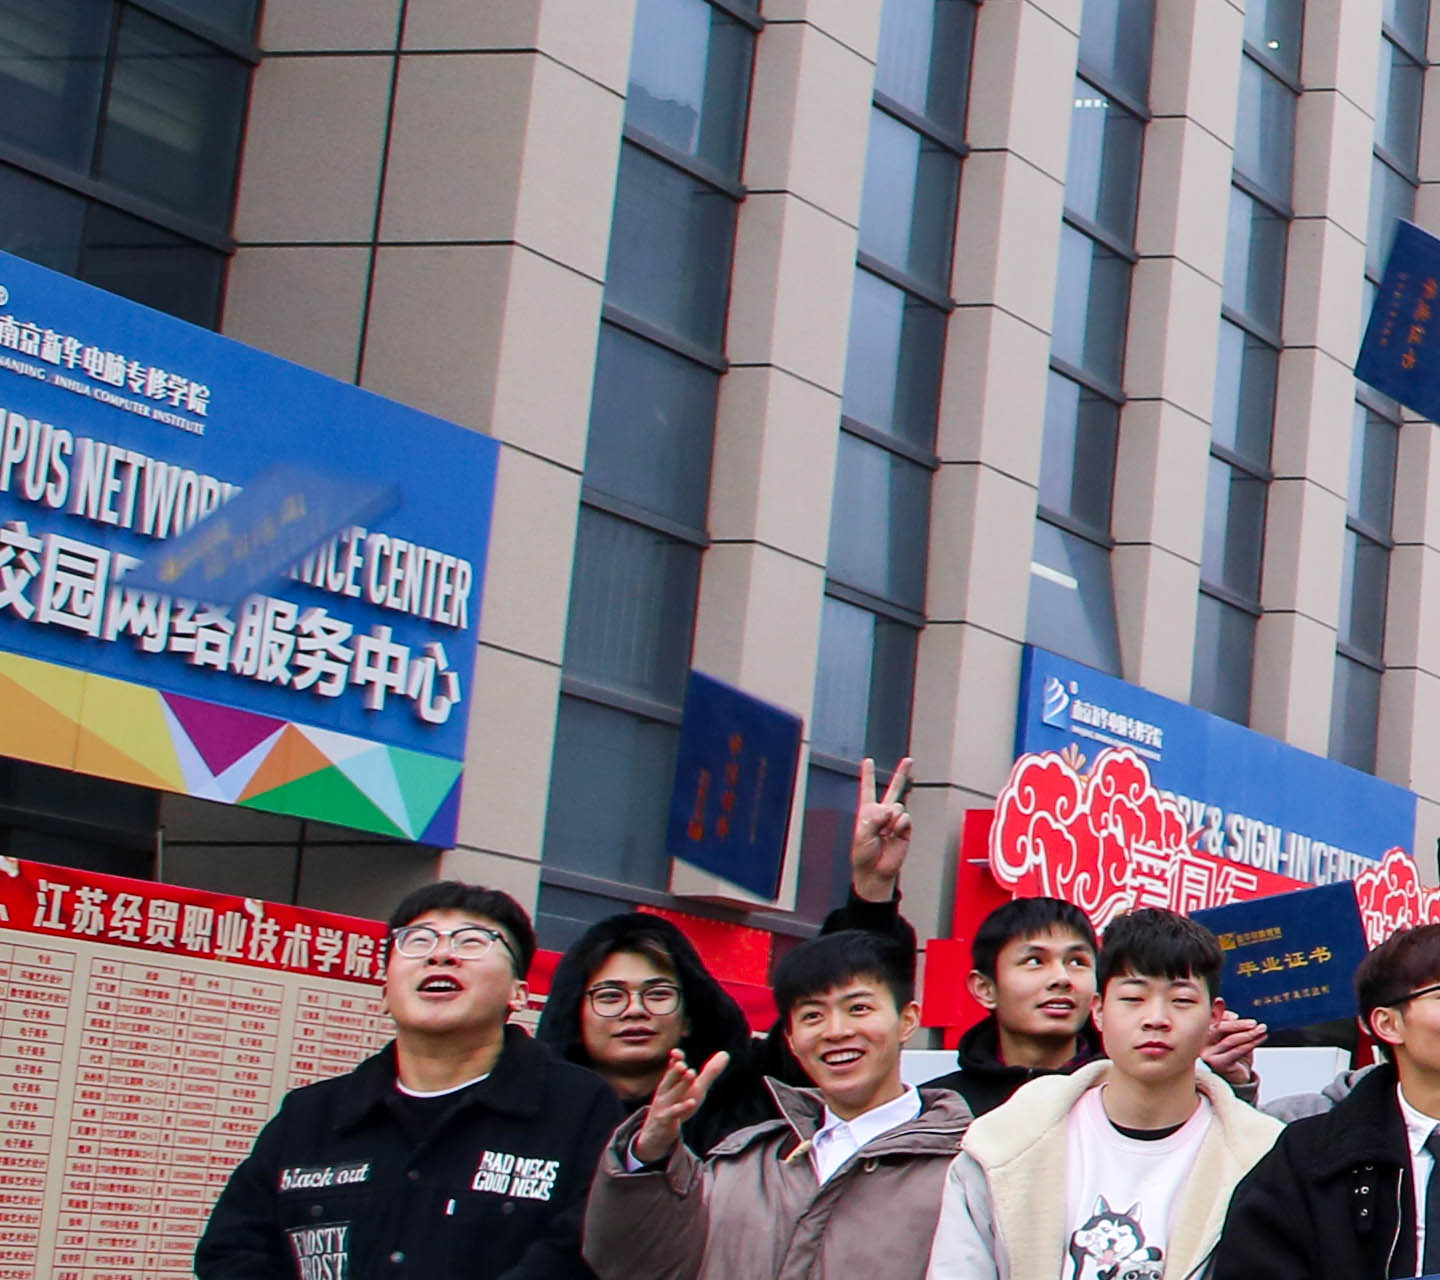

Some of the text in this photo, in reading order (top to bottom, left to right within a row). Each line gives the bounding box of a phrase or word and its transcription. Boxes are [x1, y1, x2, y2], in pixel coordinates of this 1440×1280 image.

[0, 315, 211, 416] 南京新华电脑专修学院
[93, 388, 150, 418] COMPUTER
[152, 409, 205, 436] INSTITUTE
[364, 532, 472, 630] CENTER
[1205, 804, 1226, 858] &
[1226, 812, 1312, 883] SIGN-IN
[1237, 946, 1332, 978] 毕业证书
[280, 1163, 369, 1190] black out
[472, 1170, 555, 1202] GOOD NEWS
[480, 1150, 560, 1182] BAD NEWS
